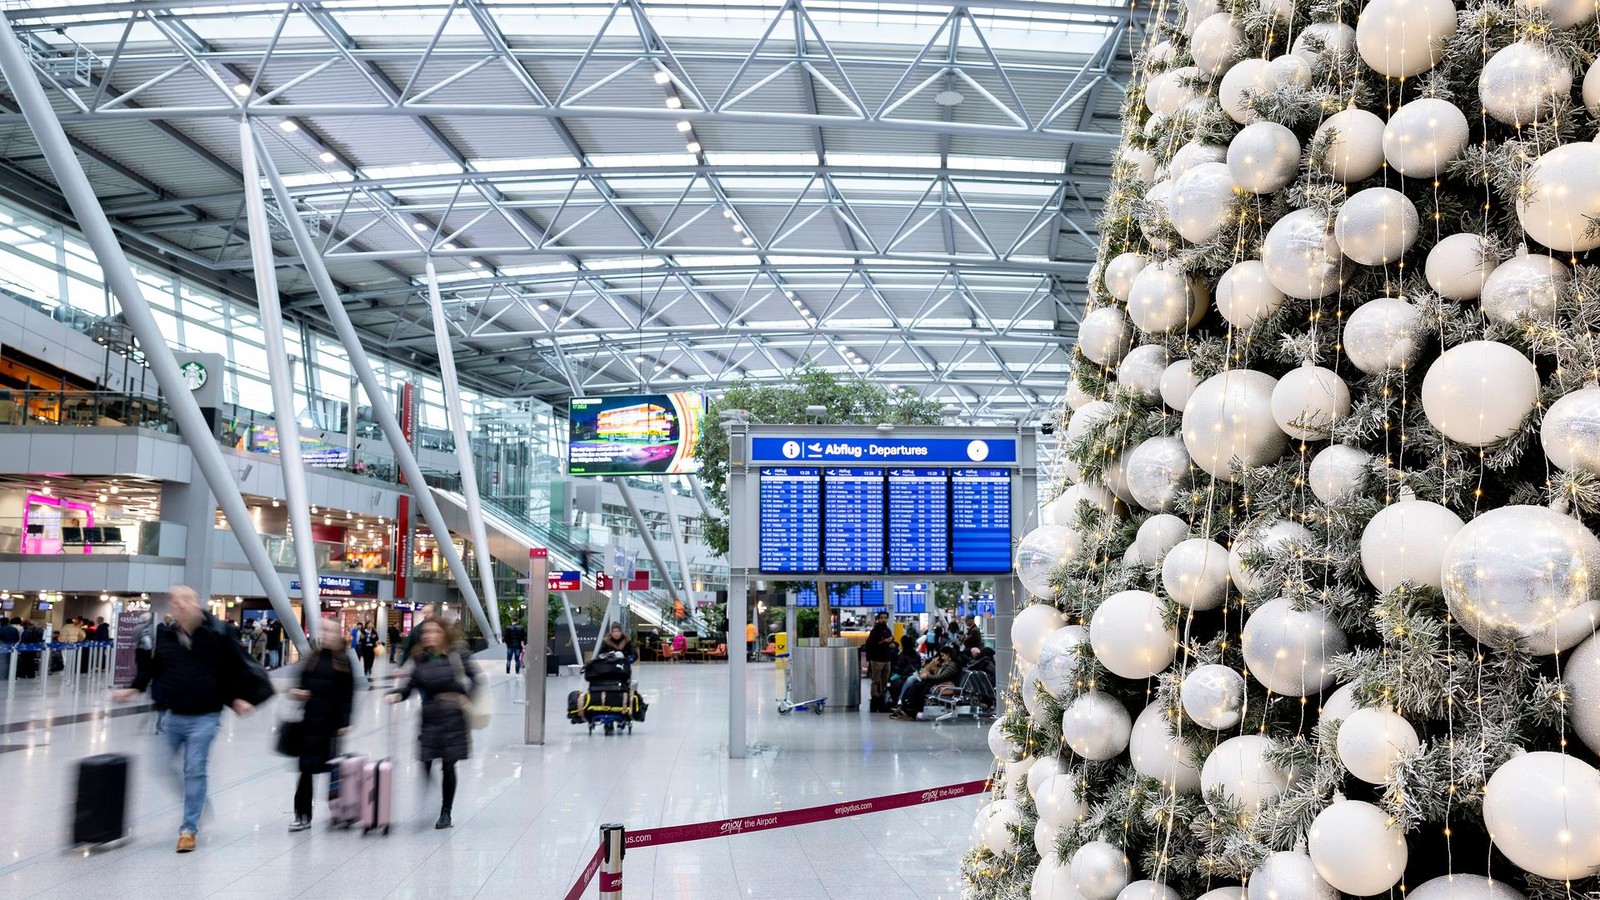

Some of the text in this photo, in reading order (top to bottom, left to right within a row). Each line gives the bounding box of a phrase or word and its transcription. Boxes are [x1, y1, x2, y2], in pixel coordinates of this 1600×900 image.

[825, 444, 927, 457] Abflug Departures
[922, 790, 939, 802] enjoy
[948, 787, 964, 795] Airport
[835, 802, 872, 816] enjoydus.com
[720, 816, 778, 834] enjoy the Airport
[625, 833, 651, 844] us.com
